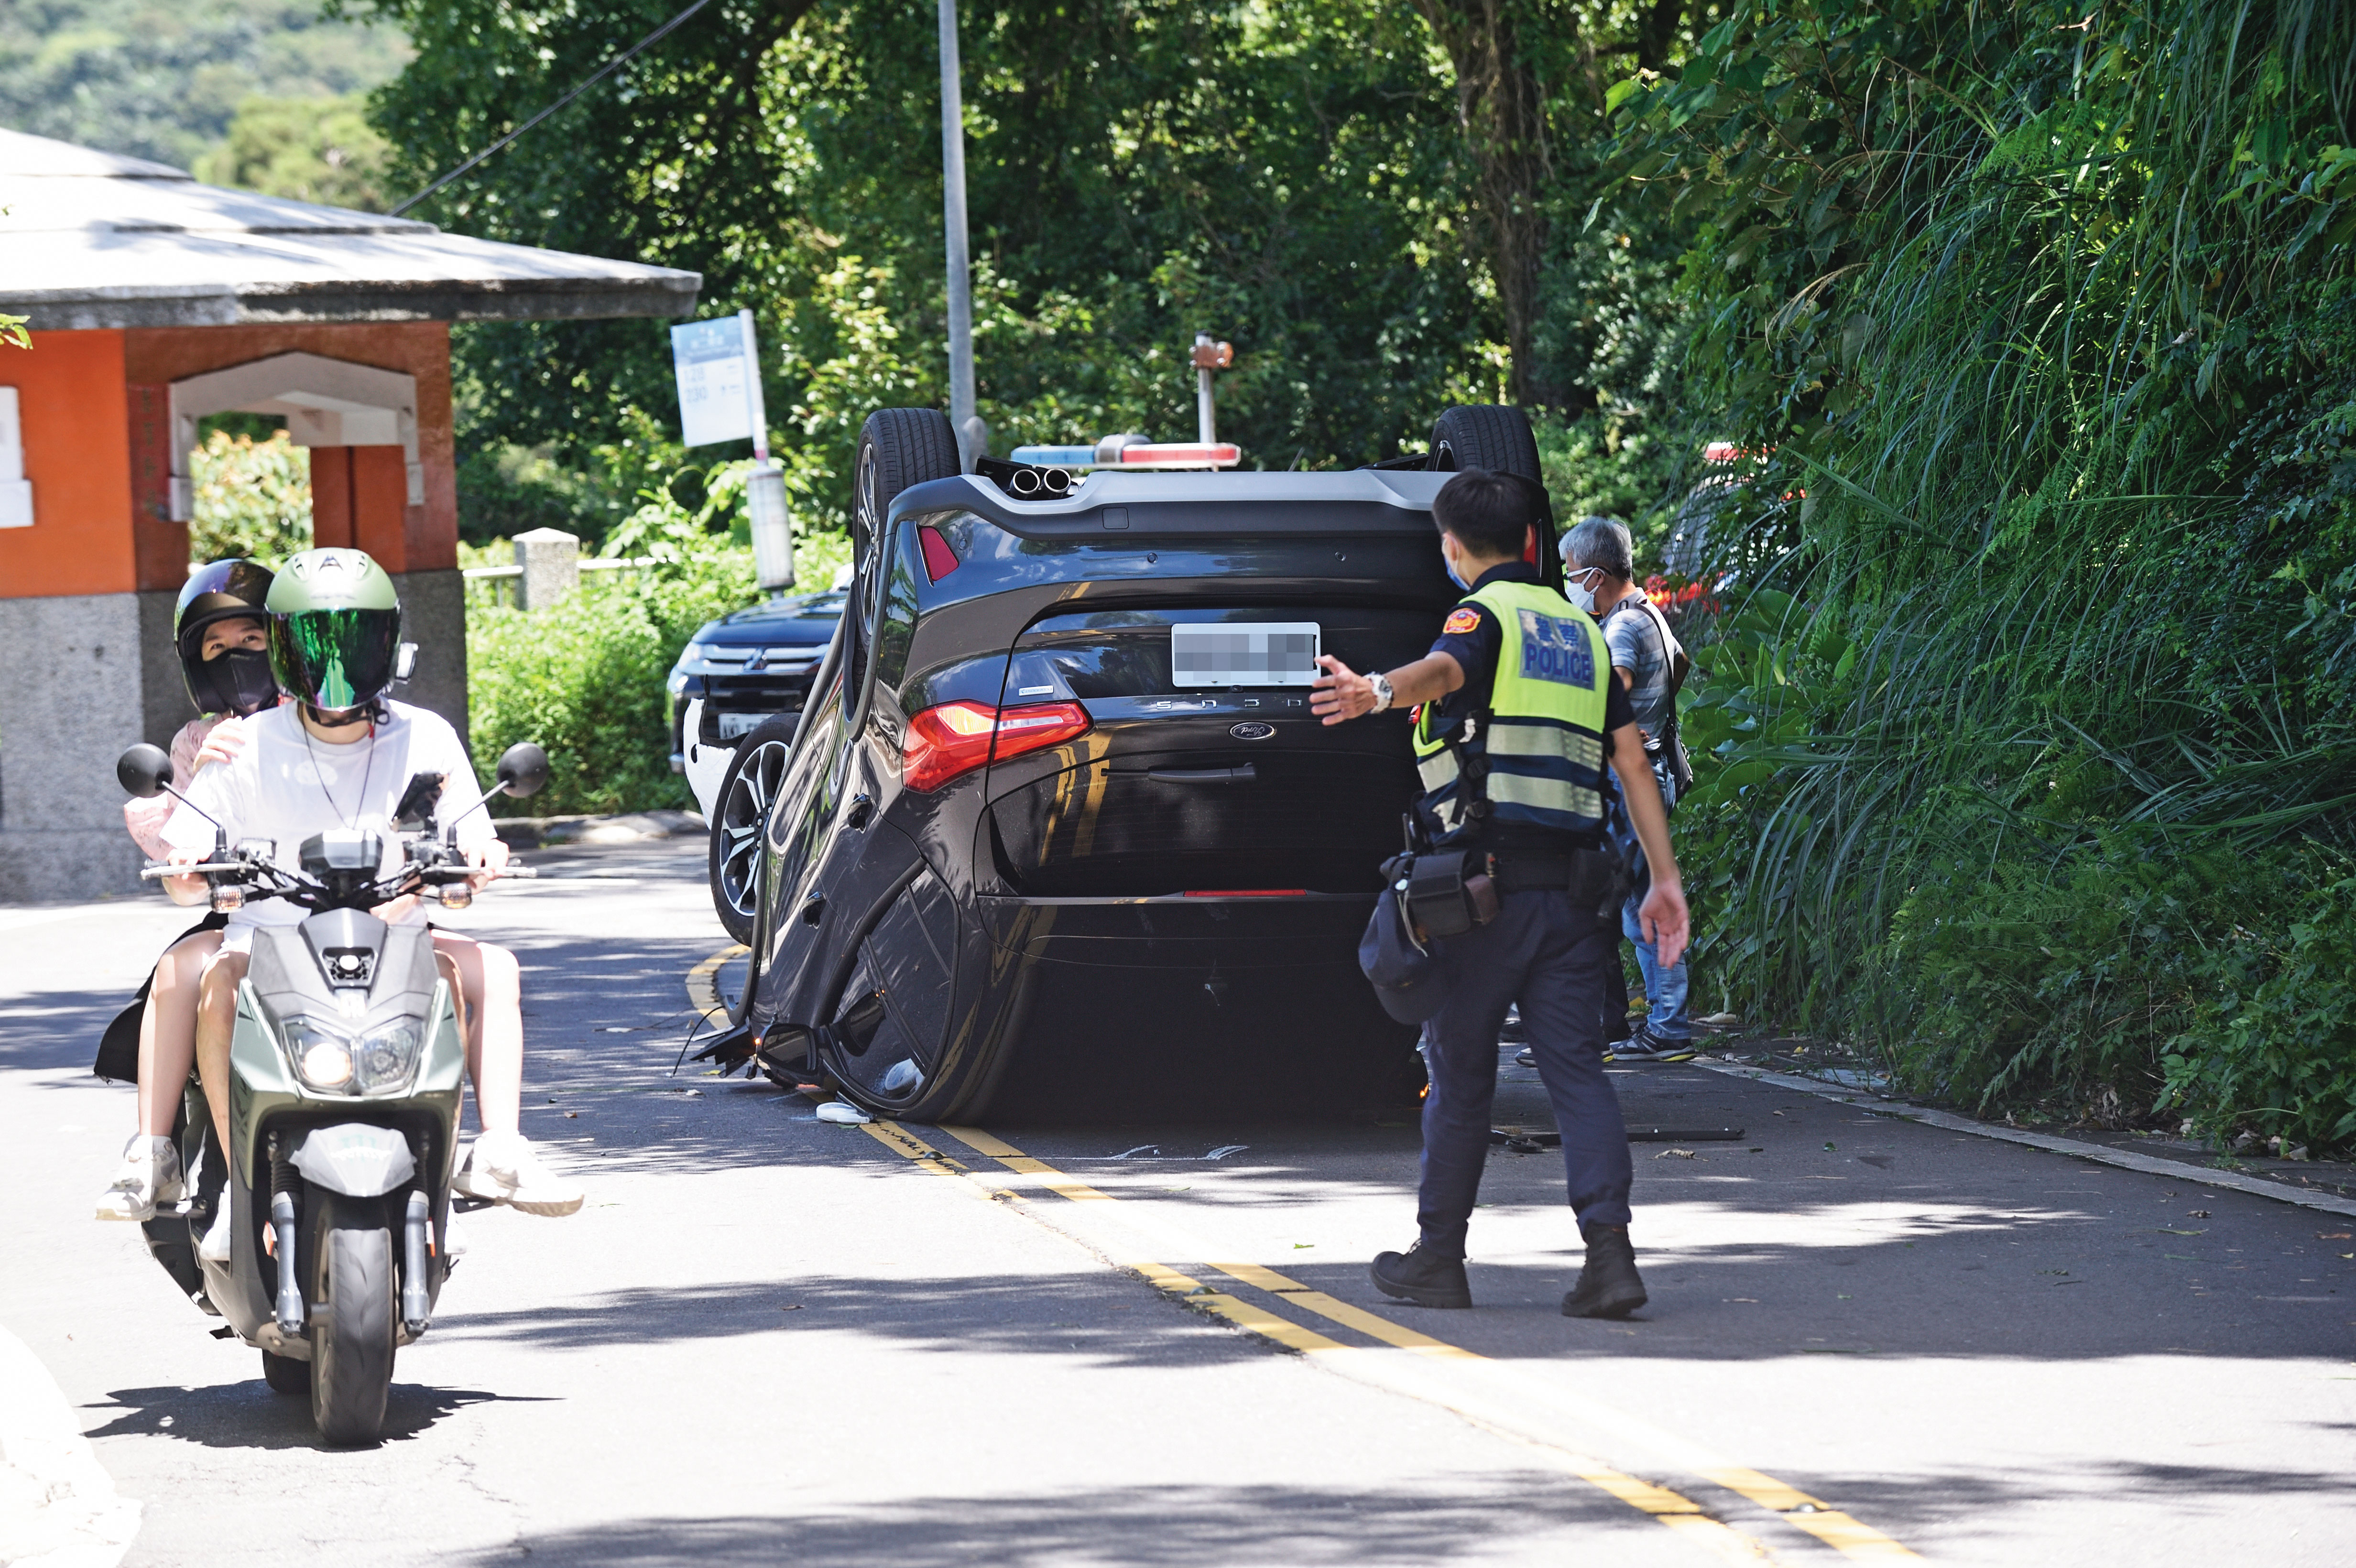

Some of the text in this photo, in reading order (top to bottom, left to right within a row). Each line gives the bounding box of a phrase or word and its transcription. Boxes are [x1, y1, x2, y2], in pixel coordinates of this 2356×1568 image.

[1525, 643, 1592, 682] POLICE
[1156, 698, 1303, 709] OCUS
[1241, 726, 1265, 736] Ford
